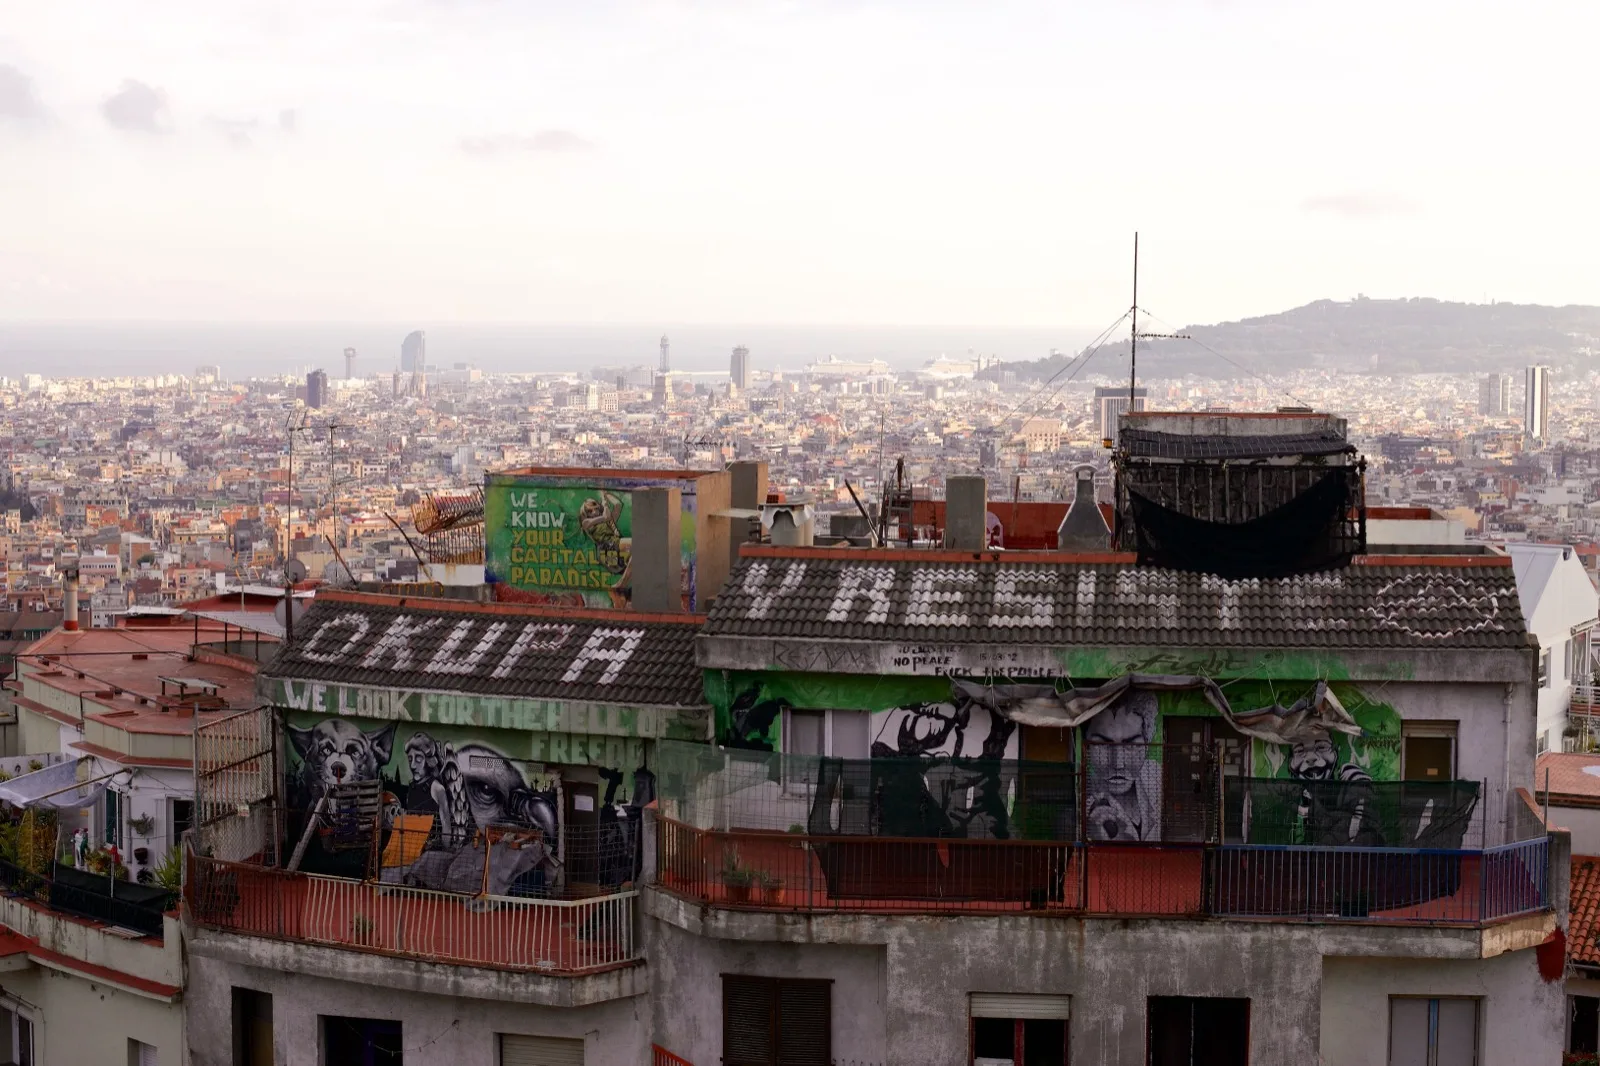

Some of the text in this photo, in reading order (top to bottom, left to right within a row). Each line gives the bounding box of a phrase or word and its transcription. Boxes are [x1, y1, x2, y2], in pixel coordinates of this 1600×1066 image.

[511, 492, 538, 508] WE
[511, 511, 565, 528] KNOW
[512, 529, 565, 546] YOUR
[301, 612, 645, 684] OKUPA
[893, 656, 910, 667] NO
[338, 686, 413, 720] LOOK
[420, 693, 475, 725] FOR
[480, 697, 546, 731] THE
